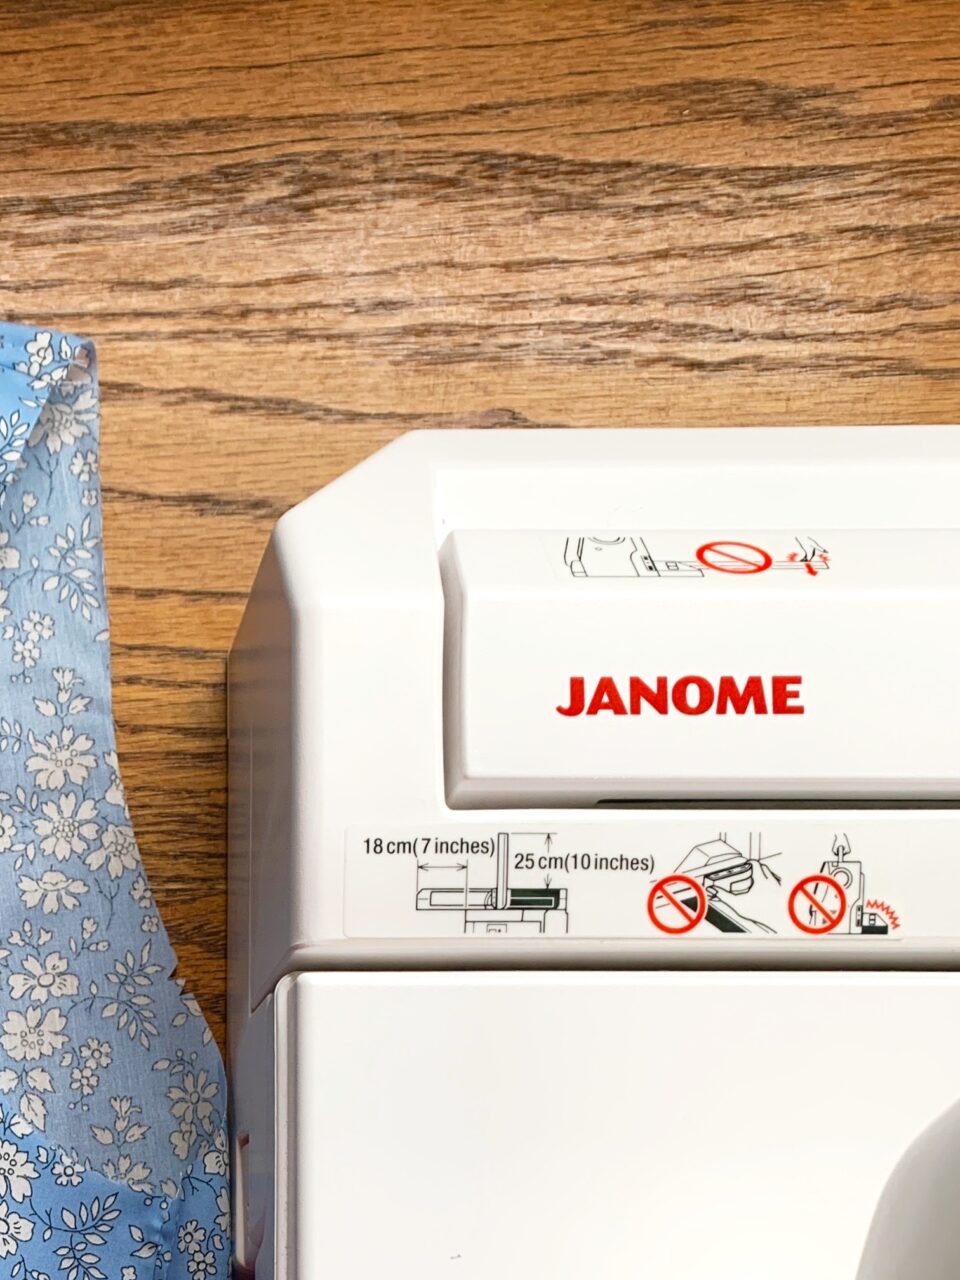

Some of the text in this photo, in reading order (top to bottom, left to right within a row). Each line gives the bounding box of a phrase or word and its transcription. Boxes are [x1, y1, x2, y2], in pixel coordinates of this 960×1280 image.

[556, 674, 805, 717] JANOME
[363, 837, 384, 855] 18
[514, 853, 535, 870] 25
